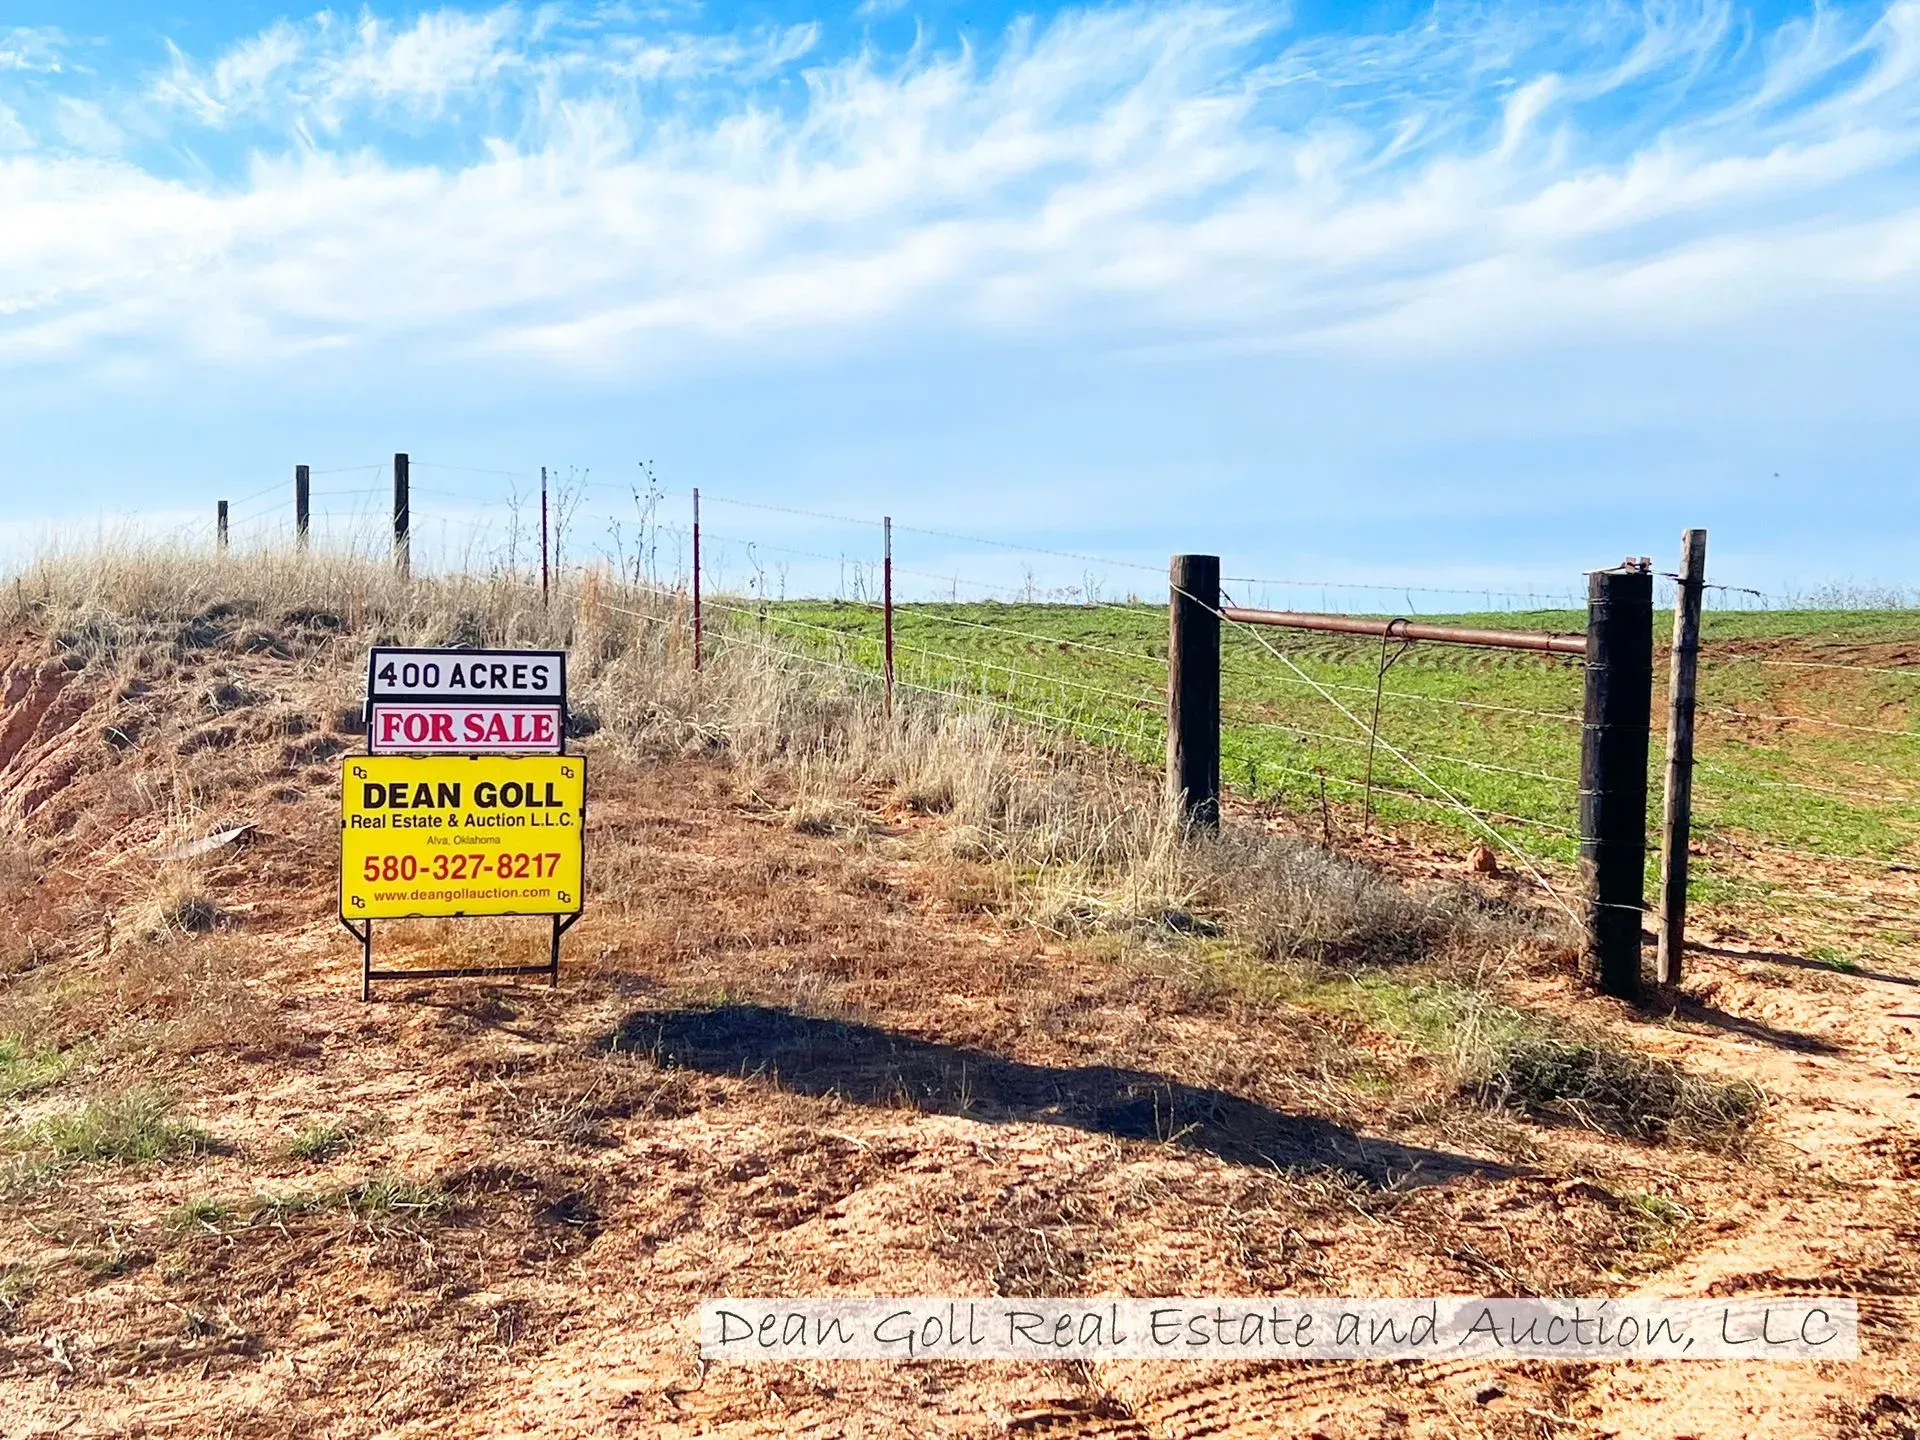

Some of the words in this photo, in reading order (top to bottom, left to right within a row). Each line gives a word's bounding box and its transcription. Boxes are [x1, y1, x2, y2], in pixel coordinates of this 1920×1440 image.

[378, 662, 440, 688] 400
[449, 663, 548, 690] ACRES
[381, 713, 457, 743] FOR
[463, 714, 554, 743] SALE
[363, 783, 461, 809] DEAN
[474, 782, 563, 808] GOLL
[351, 814, 386, 828] Real
[392, 814, 442, 828] Estate
[448, 814, 458, 827] &
[465, 813, 525, 826] Auction
[532, 813, 574, 826] L.L.C.
[427, 836, 450, 845] Alva,
[454, 835, 501, 845] Oklahoma
[363, 853, 561, 881] 580-327-8217
[374, 888, 550, 902] www.deangollauction.com
